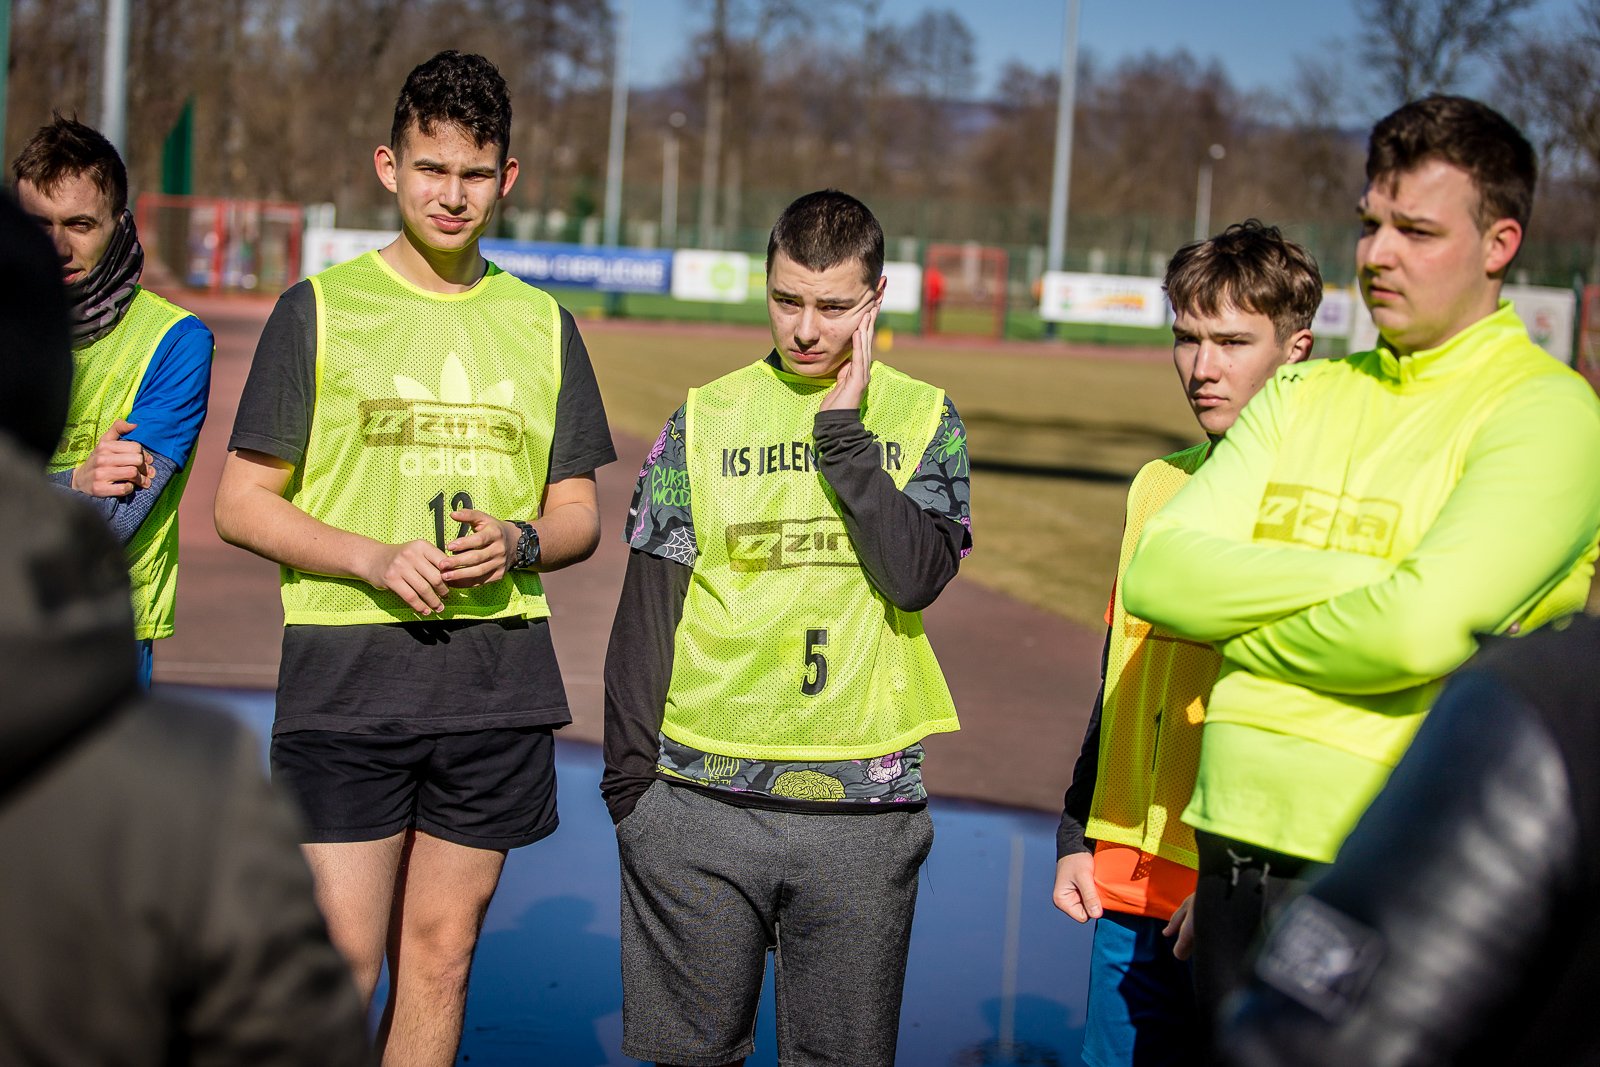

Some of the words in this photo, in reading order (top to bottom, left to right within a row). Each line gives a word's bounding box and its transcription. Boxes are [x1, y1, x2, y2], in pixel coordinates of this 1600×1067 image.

[722, 447, 750, 477] KS
[757, 441, 820, 477] JELEN
[785, 532, 854, 553] zin
[801, 627, 829, 696] 5
